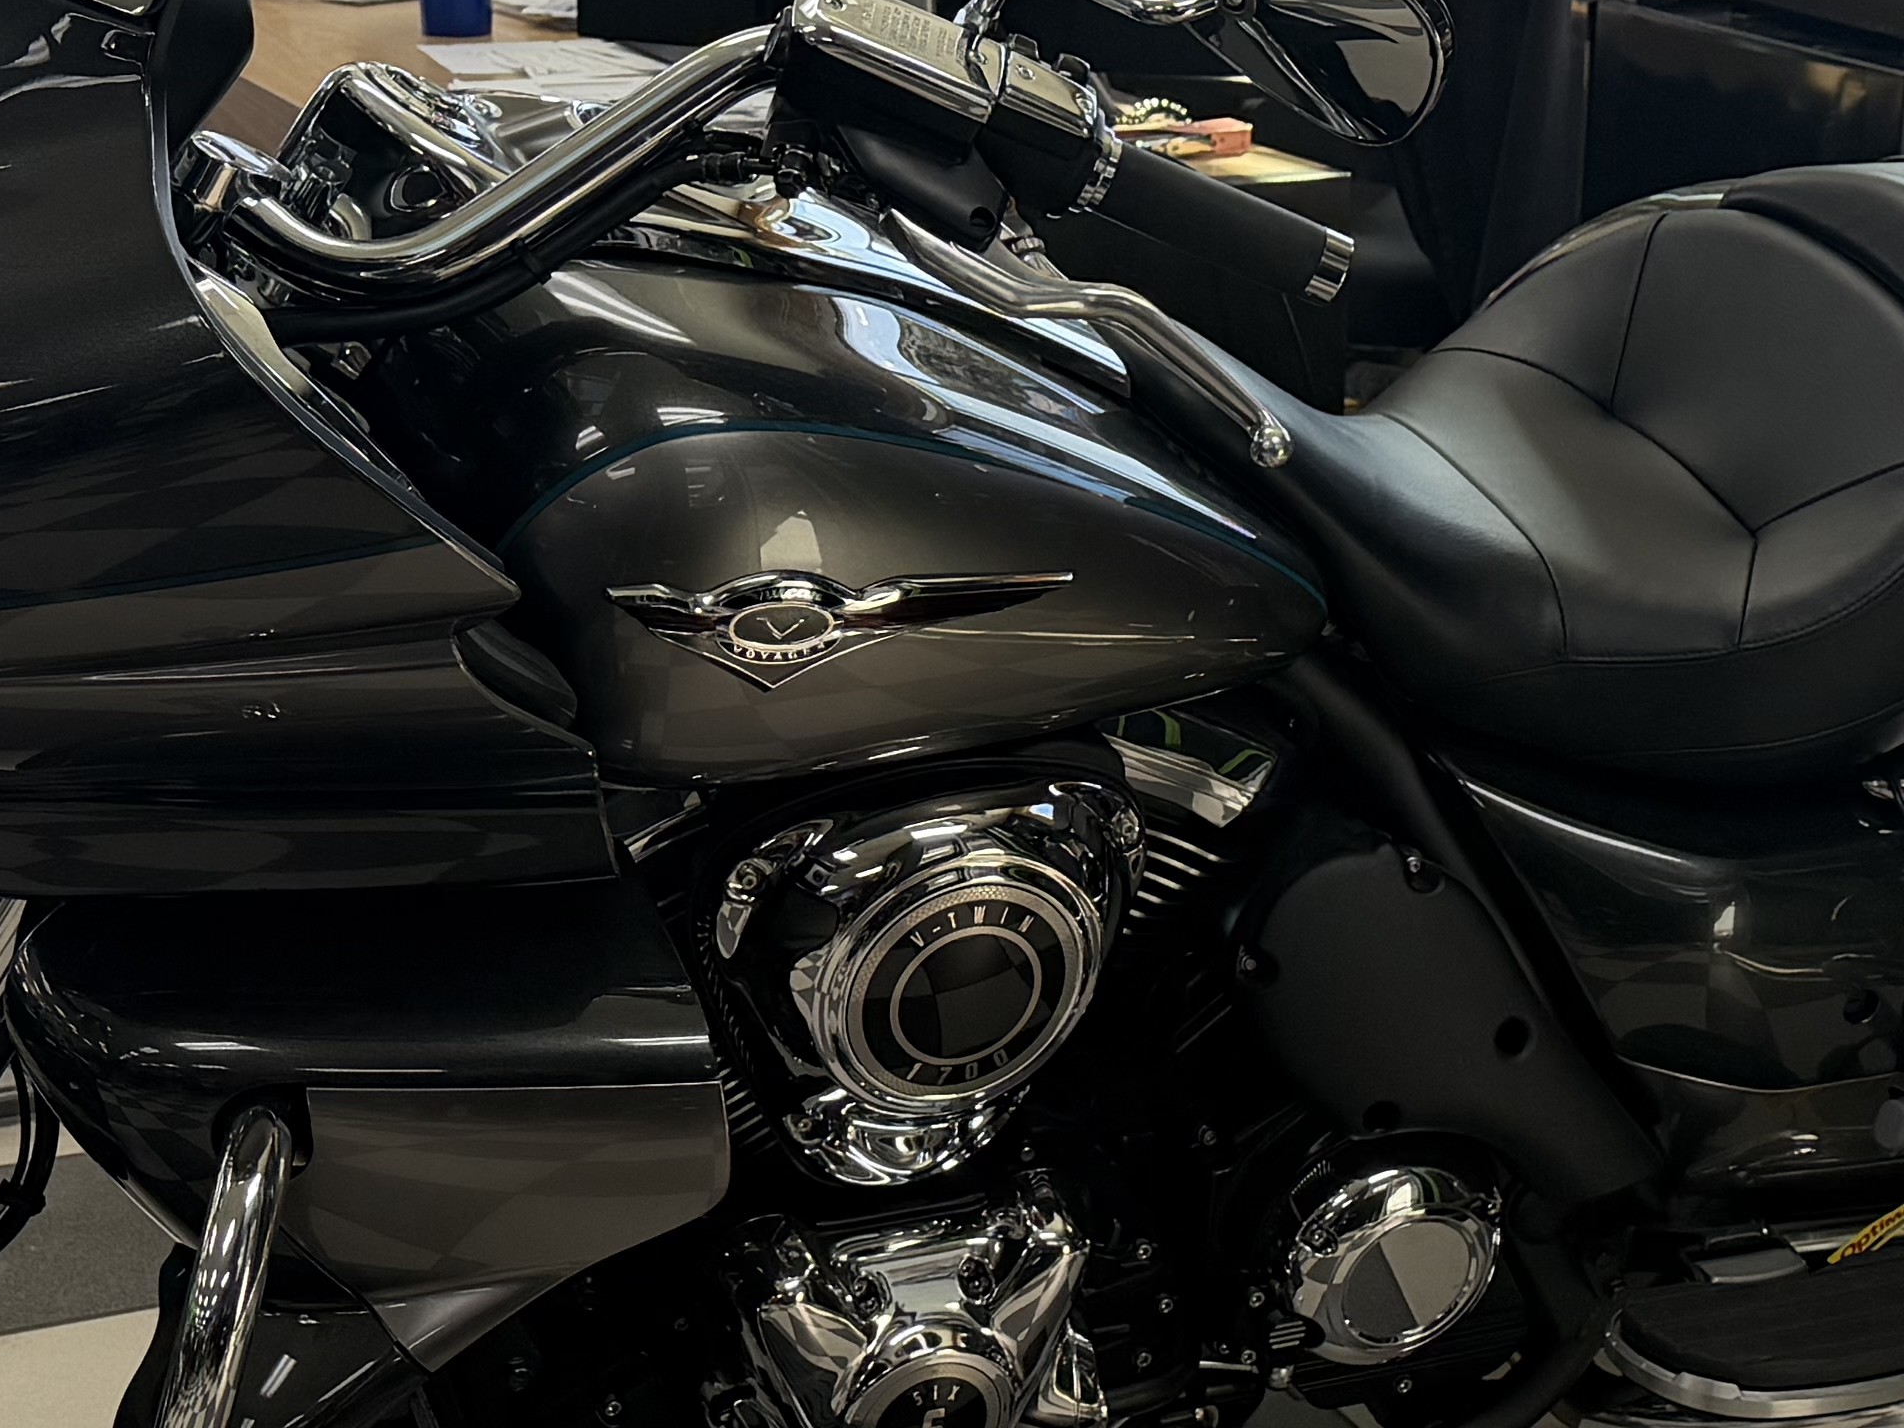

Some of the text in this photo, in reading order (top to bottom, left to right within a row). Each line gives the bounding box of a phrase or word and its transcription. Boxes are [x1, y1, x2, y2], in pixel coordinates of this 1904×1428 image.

[733, 639, 826, 662] VOYAGER
[909, 904, 1035, 948] V-TWIN
[906, 1047, 1009, 1086] 1700
[912, 1383, 961, 1407] SIX
